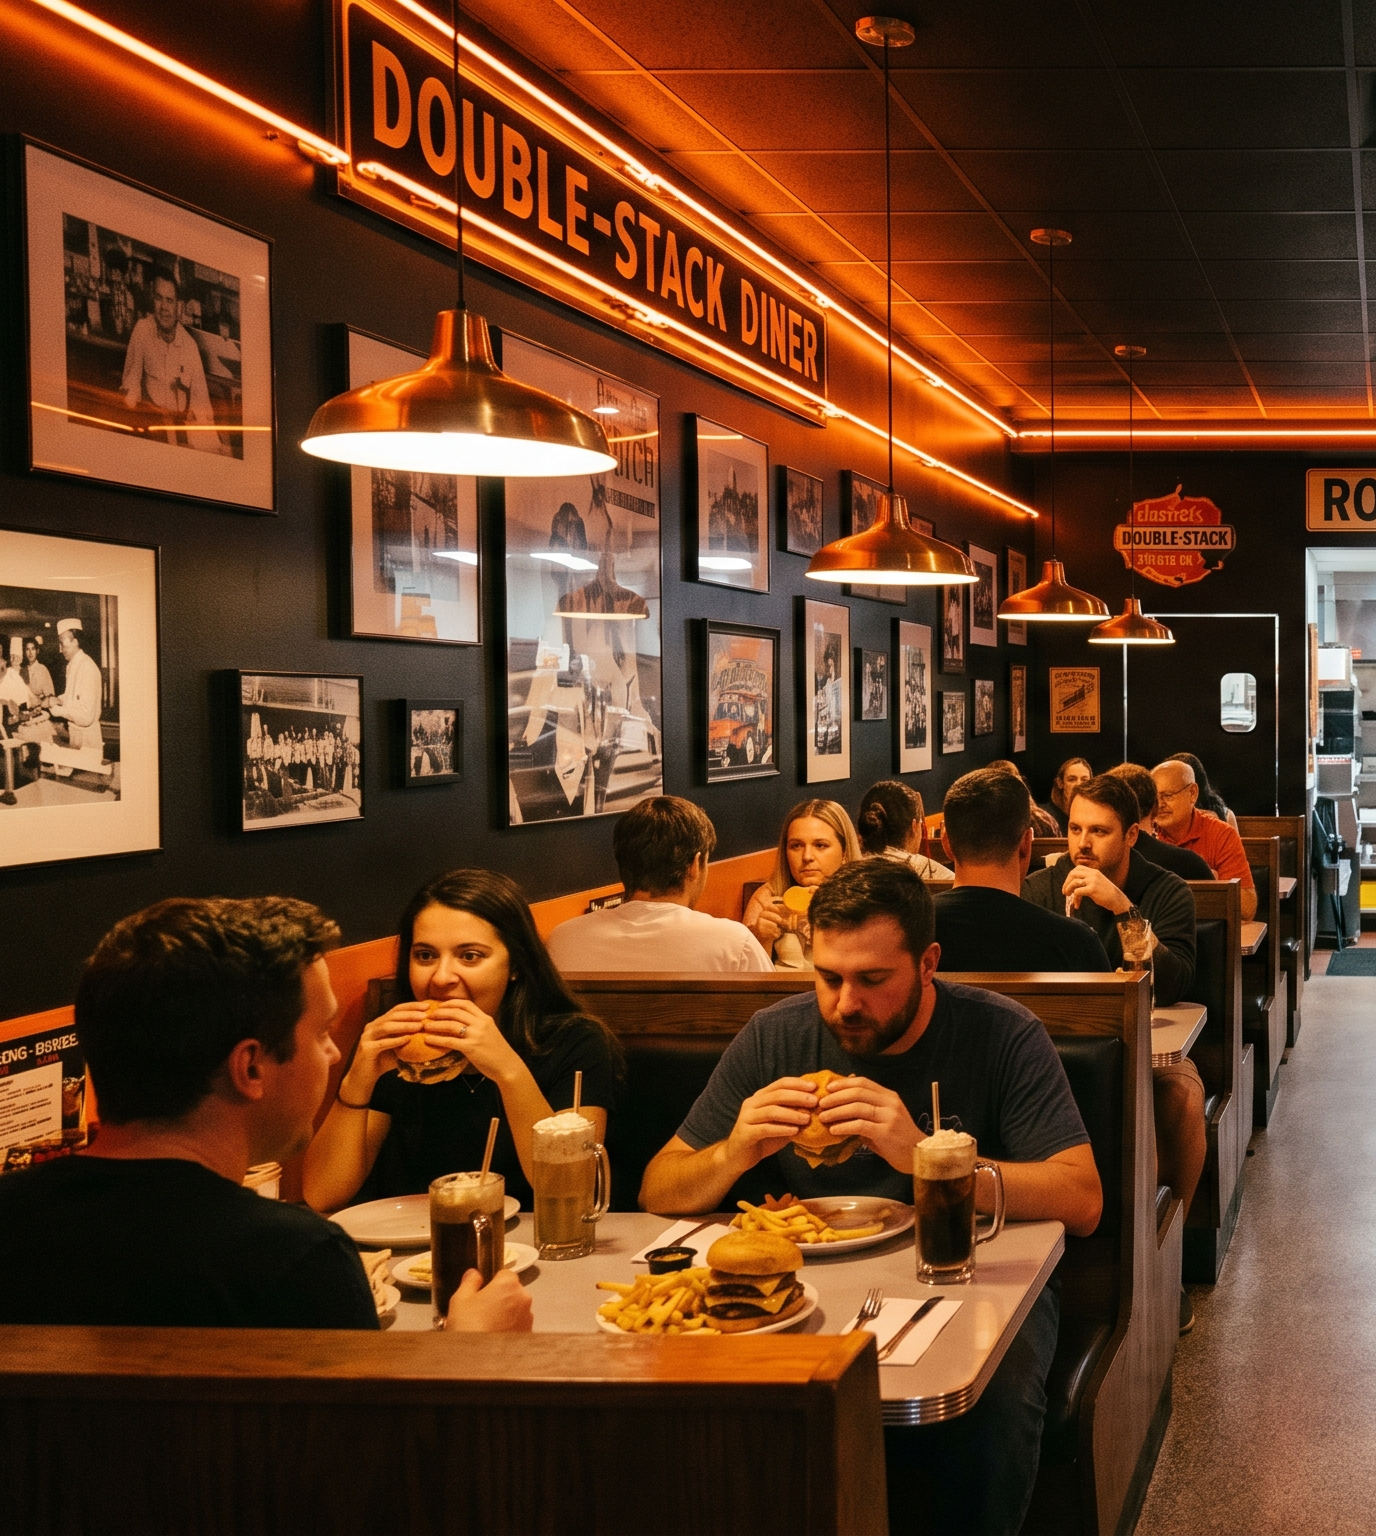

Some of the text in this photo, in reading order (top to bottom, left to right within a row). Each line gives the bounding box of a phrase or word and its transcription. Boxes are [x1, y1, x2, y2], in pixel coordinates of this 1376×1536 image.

[371, 40, 818, 382] DOUBLE-STACK DINER
[1122, 530, 1229, 546] DOUBLE-STACK
